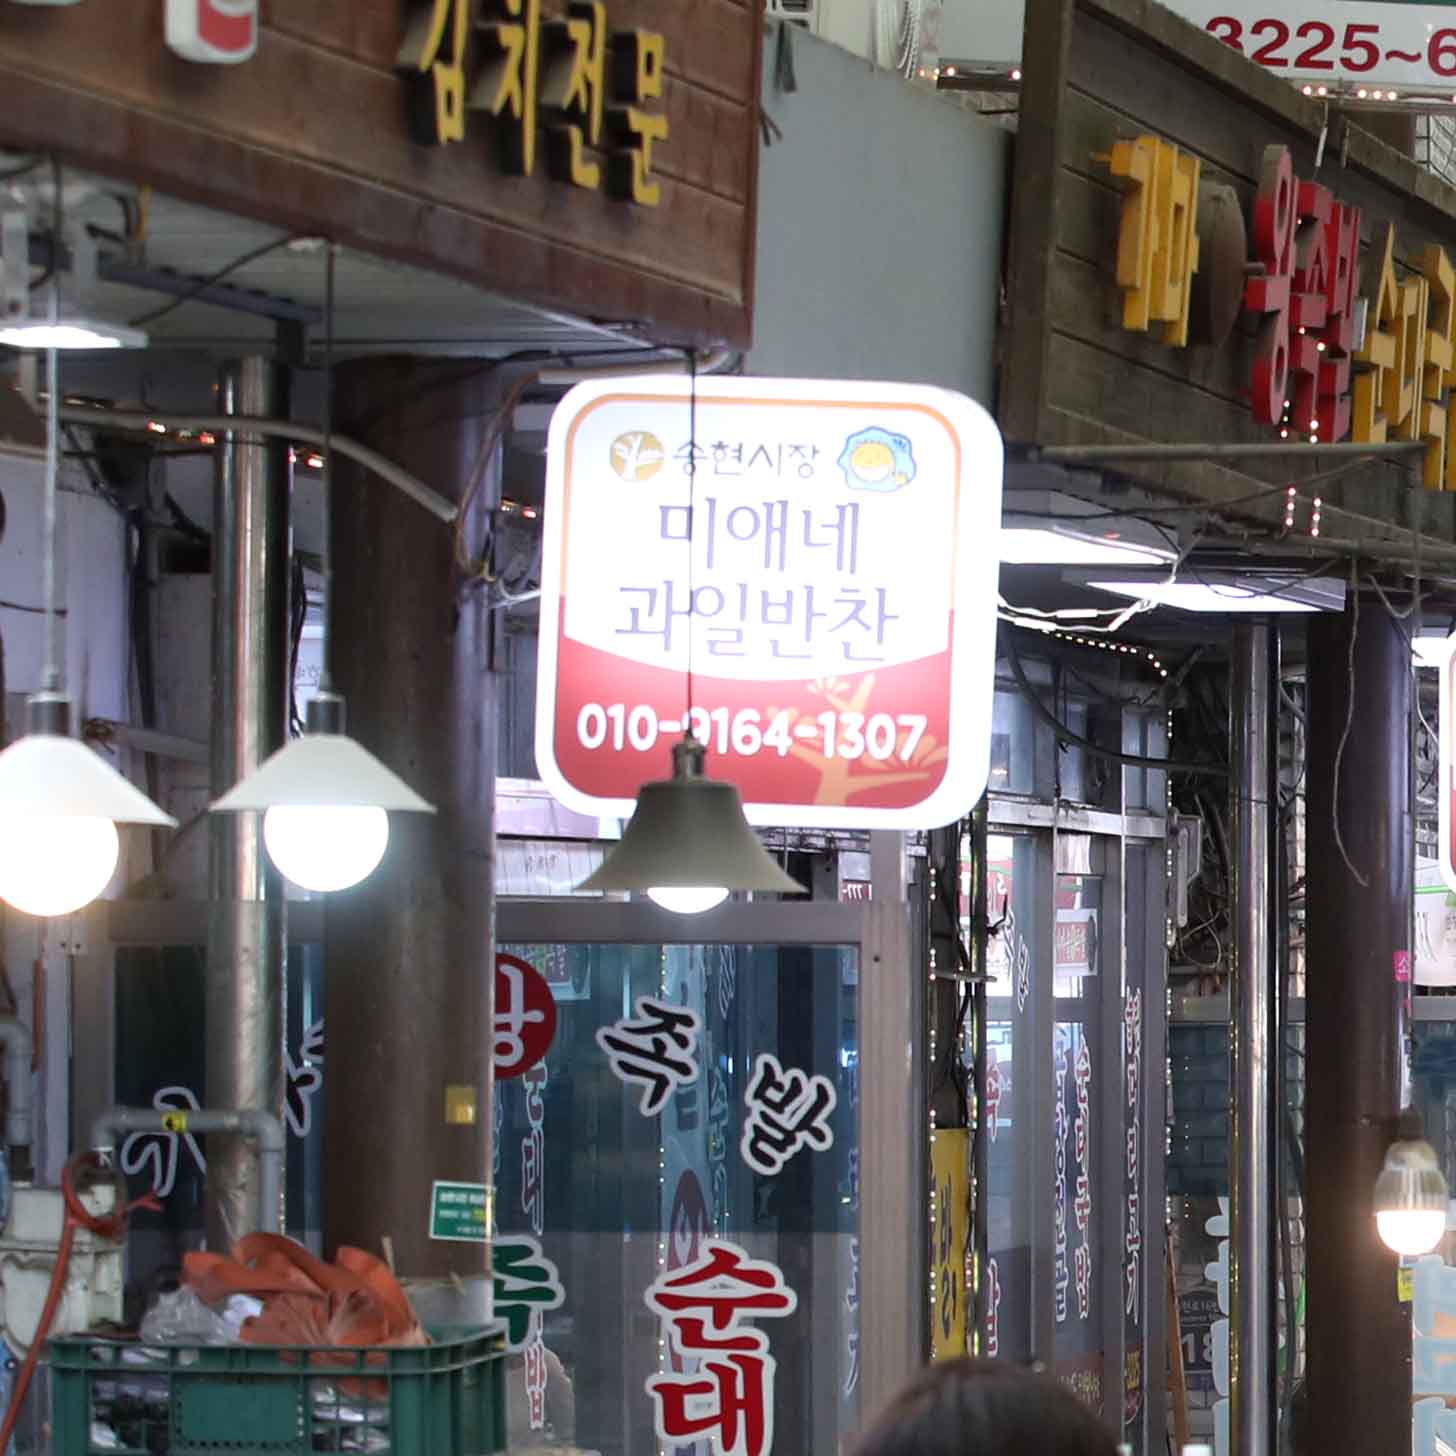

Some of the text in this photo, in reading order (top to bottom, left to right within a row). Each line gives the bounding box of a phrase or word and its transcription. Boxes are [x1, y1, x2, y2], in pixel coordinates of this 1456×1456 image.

[672, 440, 820, 480] 송현시장
[659, 496, 861, 575] 미애네
[614, 580, 899, 662] 과일반찬
